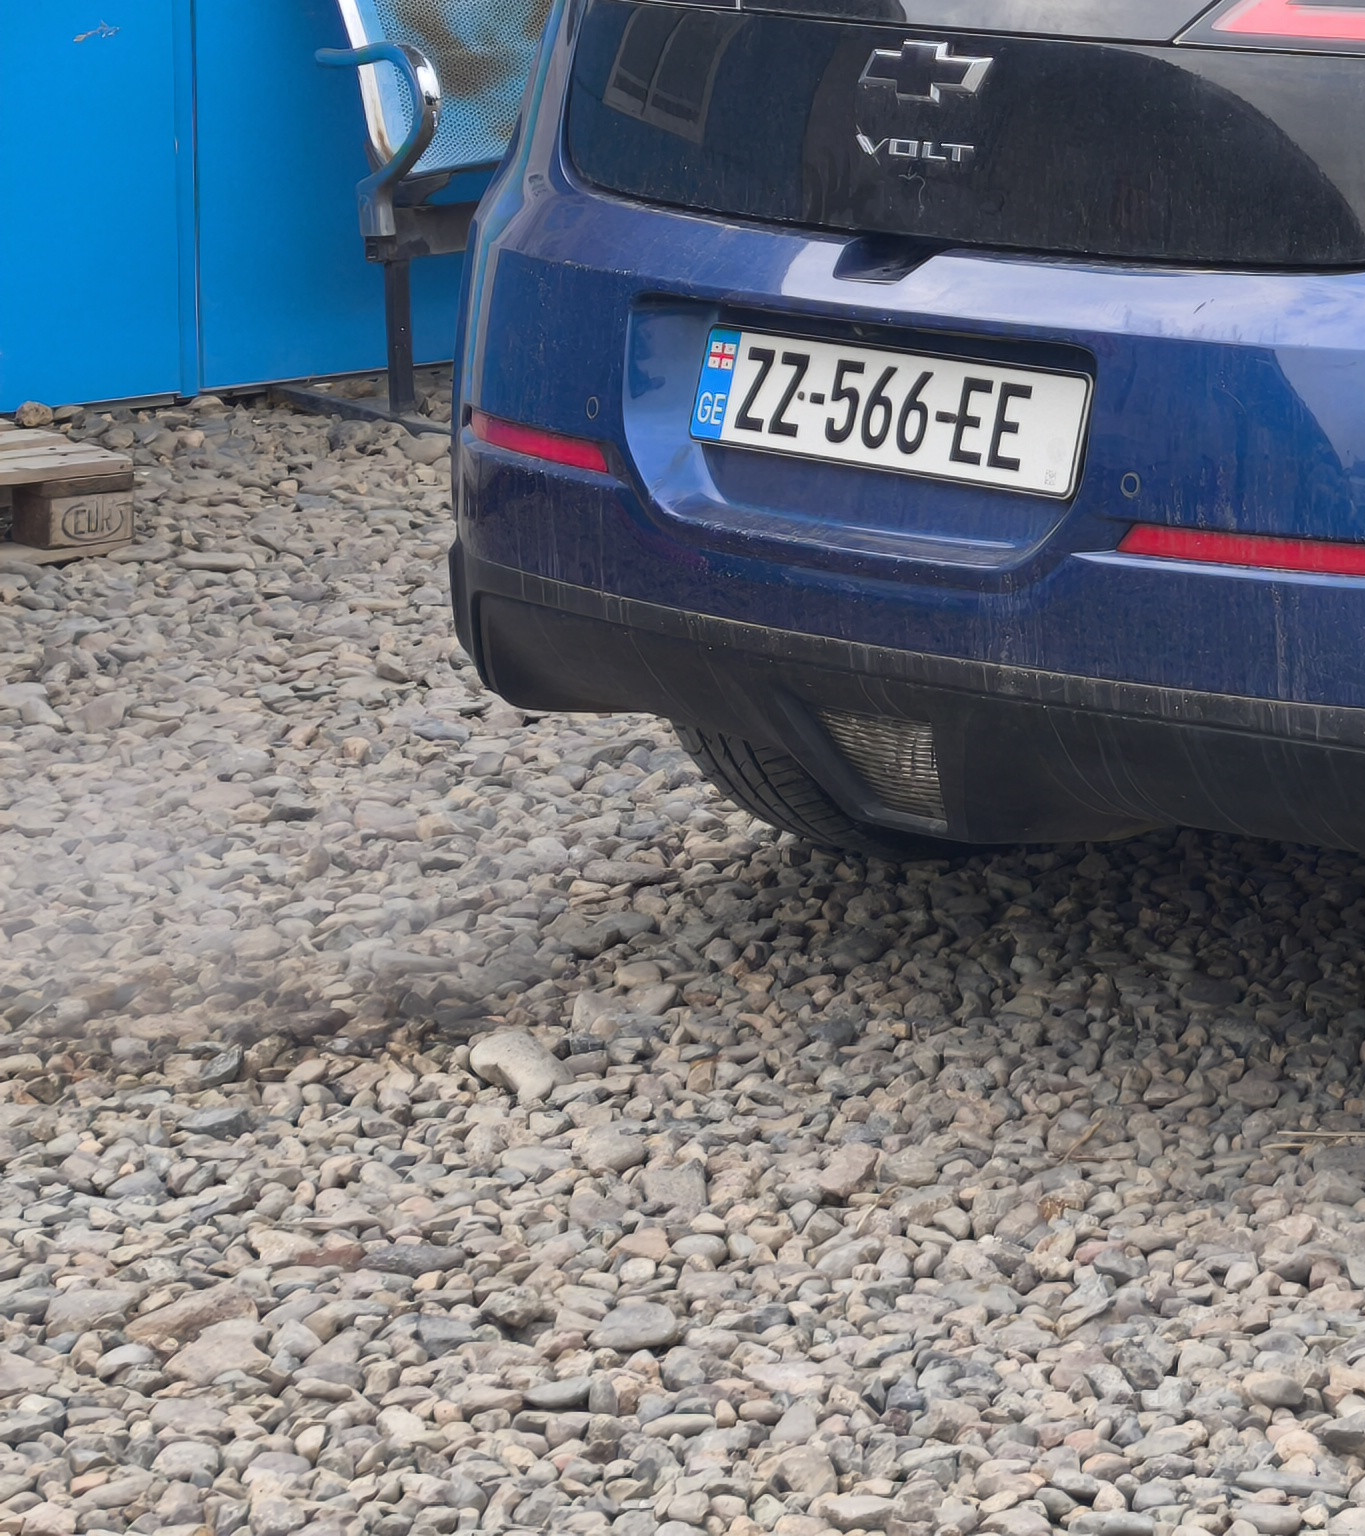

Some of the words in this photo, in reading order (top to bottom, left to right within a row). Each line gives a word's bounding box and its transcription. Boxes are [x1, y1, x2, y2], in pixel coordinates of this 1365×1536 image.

[856, 134, 975, 163] VOLT
[697, 392, 727, 424] GE
[734, 348, 1032, 471] ZZ-566-EE
